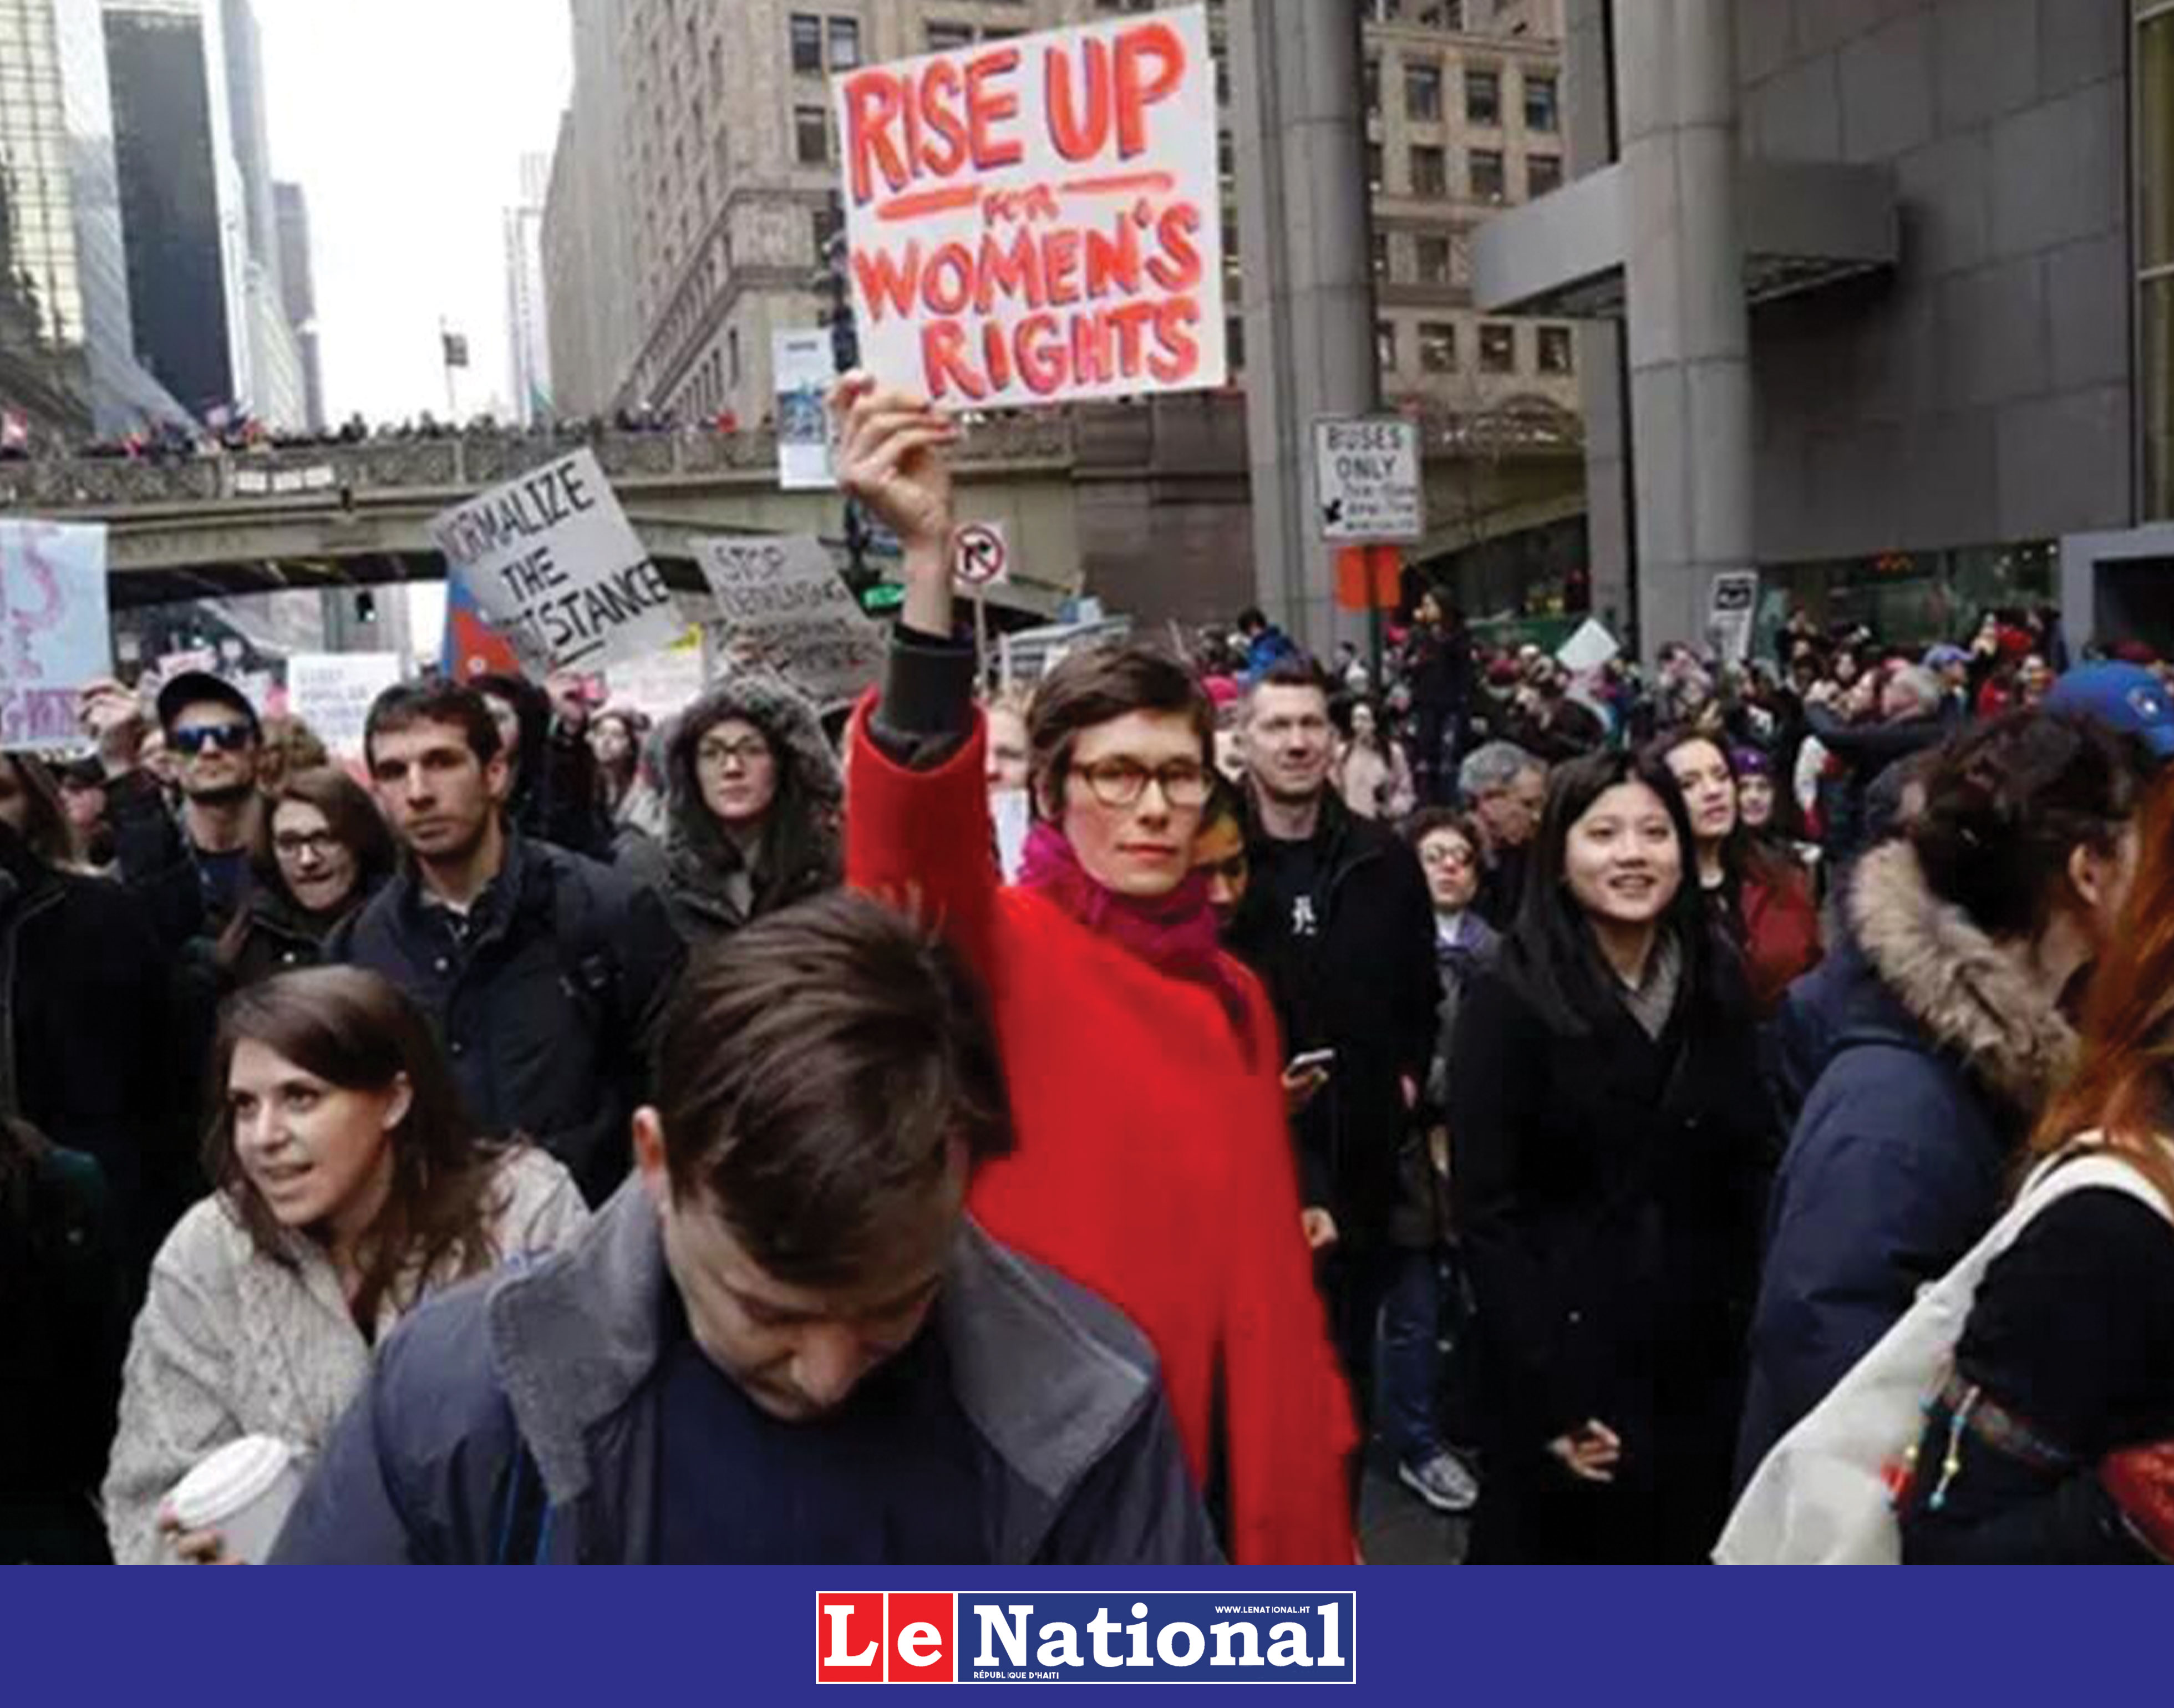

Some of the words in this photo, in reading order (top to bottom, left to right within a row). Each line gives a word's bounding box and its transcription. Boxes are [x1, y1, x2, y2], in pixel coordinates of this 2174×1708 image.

[844, 48, 1023, 206] RISE
[1045, 23, 1186, 161] UP
[851, 198, 1202, 322] WOMEN'S
[921, 296, 1200, 401] RIGHTS
[1336, 455, 1397, 480] ONLY
[501, 546, 568, 602] THE
